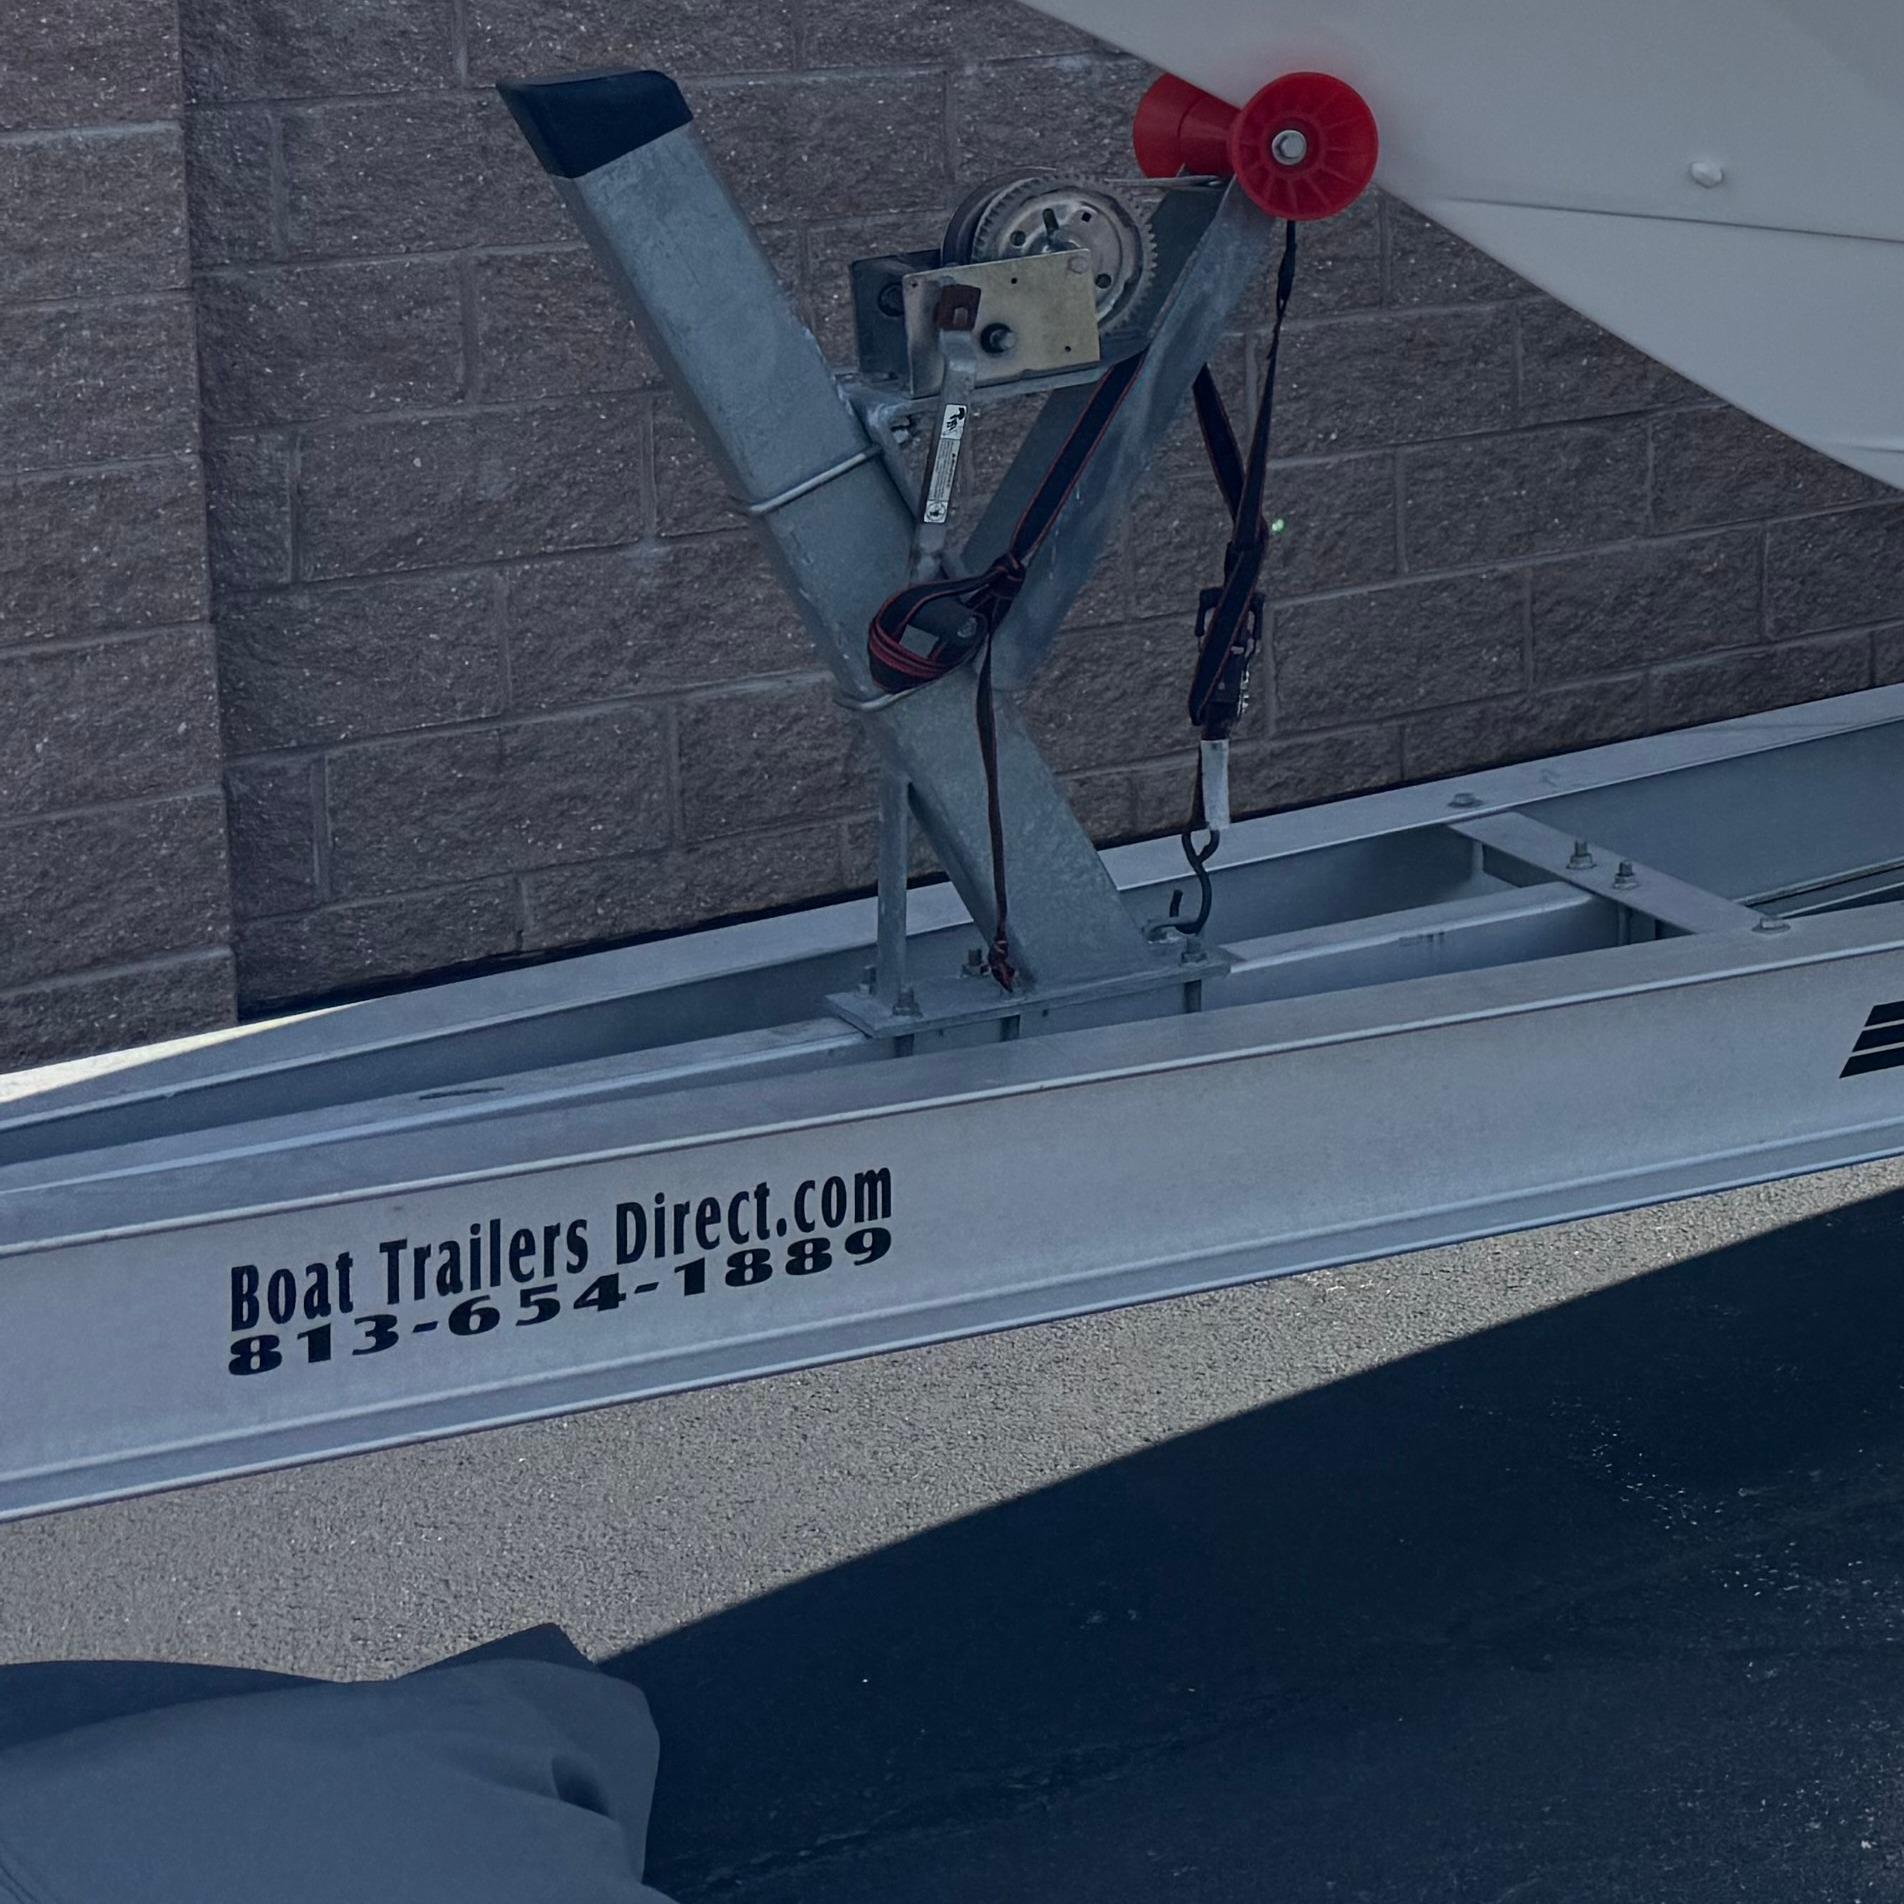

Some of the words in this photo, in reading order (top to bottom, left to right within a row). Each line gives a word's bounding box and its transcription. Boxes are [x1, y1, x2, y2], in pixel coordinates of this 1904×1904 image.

[228, 1226, 893, 1376] 813-654-1889
[231, 1251, 354, 1332] Boat
[379, 1217, 590, 1305] Trailers
[616, 1166, 892, 1265] Direct.com
